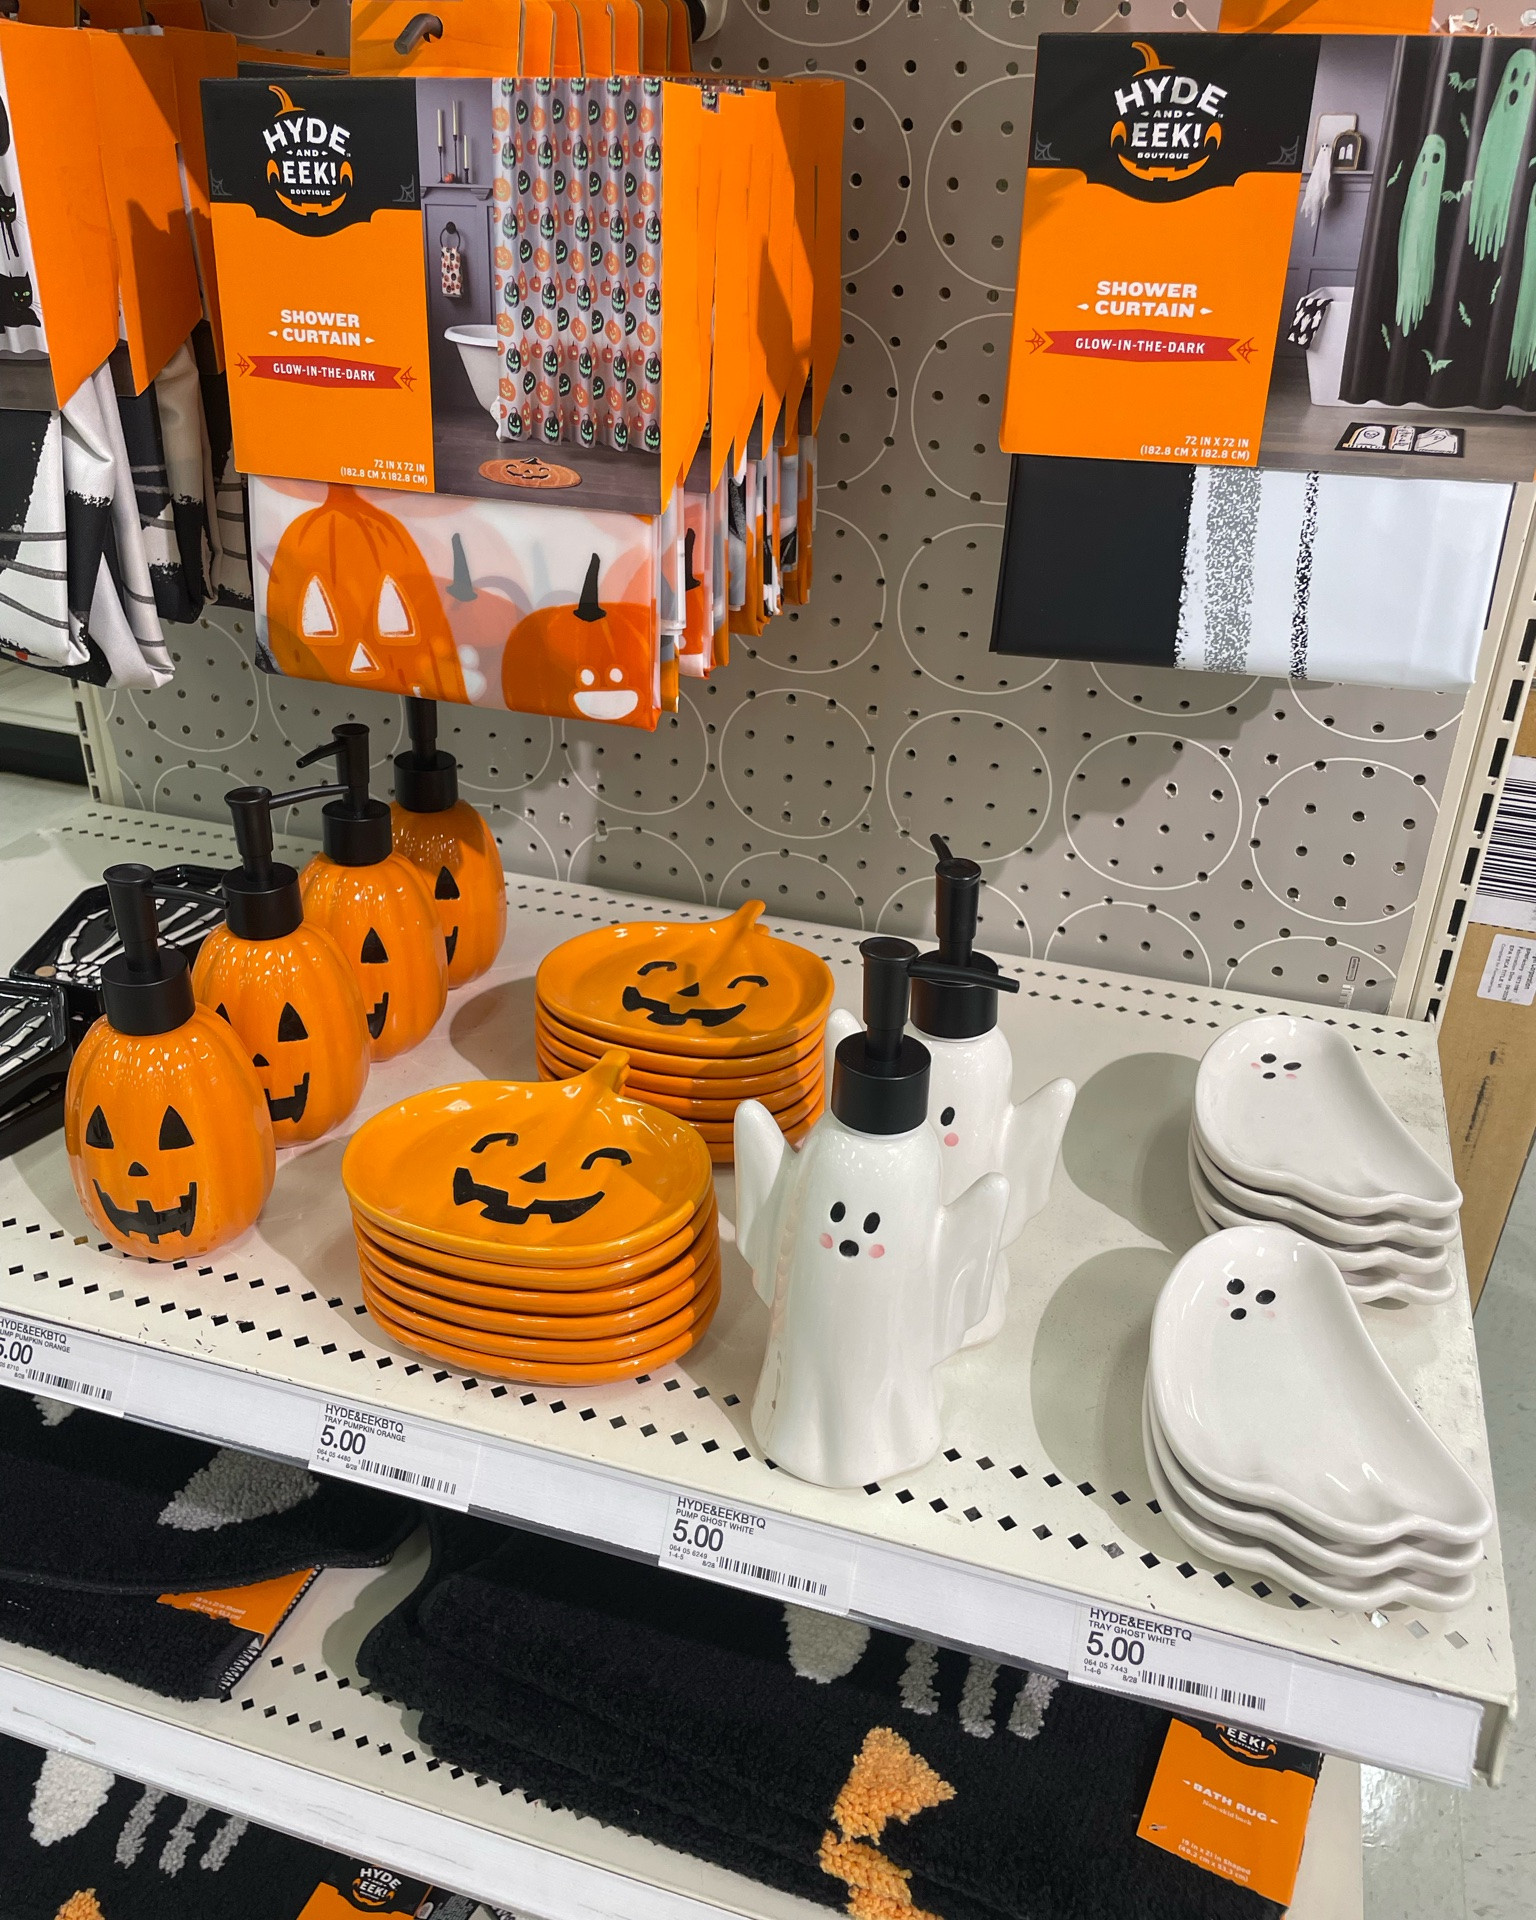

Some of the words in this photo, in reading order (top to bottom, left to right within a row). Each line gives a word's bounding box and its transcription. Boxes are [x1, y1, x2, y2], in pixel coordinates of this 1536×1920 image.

[1114, 75, 1228, 116] HYDE
[1153, 110, 1183, 118] AND
[262, 117, 351, 156] HYDE
[1131, 122, 1202, 148] EEK!
[296, 149, 319, 157] AND
[282, 160, 337, 186] EEK!
[1096, 280, 1198, 299] SHOWER
[280, 309, 360, 328] SHOWER
[1094, 300, 1194, 318] CURTAIN
[282, 328, 361, 346] CURTAIN
[1075, 337, 1206, 354] GLOW-IN-THE-DARK
[273, 362, 376, 382] GLOW-IN-THE-DARK
[1185, 435, 1197, 446] 72
[1200, 436, 1211, 447] IN
[1214, 437, 1221, 447] X
[1222, 438, 1234, 448] 72
[1238, 438, 1249, 449] IN
[1140, 444, 1171, 457] (182.8
[1174, 447, 1189, 458] CM
[1191, 449, 1199, 458] X
[1200, 449, 1228, 460] 182.8
[1231, 450, 1250, 462] CM)
[340, 466, 365, 479] (182.8
[367, 470, 379, 480] CM
[381, 472, 387, 481] X
[388, 472, 411, 483] 182.8
[413, 474, 428, 486] CM)
[373, 459, 384, 469] 72
[386, 460, 395, 470] IN
[397, 462, 403, 471] X
[404, 462, 415, 472] 72
[417, 463, 425, 473] IN
[0, 1318, 67, 1344] HYDE&EEKBTQ
[0, 1328, 14, 1337] UMP
[15, 1333, 43, 1346] PUMPKIN
[44, 1341, 70, 1353] ORANGE
[325, 1403, 404, 1434] HYDE&EEKBTQ
[324, 1415, 342, 1426] TRAY
[343, 1420, 375, 1434] PUMPKIN
[376, 1429, 406, 1443] ORANGE
[320, 1424, 366, 1455] 5.00
[316, 1455, 330, 1463] 1-4-4
[675, 1508, 699, 1520] PUMP
[700, 1515, 727, 1528] GHOST
[729, 1523, 755, 1535] WHITE
[677, 1496, 767, 1530] HYDE&EEKBTQ
[672, 1518, 724, 1552] 5.00
[668, 1551, 684, 1561] 1-4-5
[669, 1543, 681, 1552] 064
[682, 1547, 691, 1555] 05
[692, 1550, 708, 1560] 6249
[702, 1560, 716, 1569] 8/28
[1088, 1619, 1112, 1632] TRAY
[1114, 1626, 1145, 1640] GHOST
[1147, 1633, 1177, 1647] WHITE
[1089, 1607, 1193, 1642] HYDE&EEKBTQ
[1086, 1630, 1145, 1666] 5.00
[1083, 1658, 1098, 1667] 064
[1099, 1662, 1109, 1670] 05
[1110, 1664, 1128, 1674] 7443
[1083, 1665, 1102, 1676] 1-4-6
[1122, 1675, 1138, 1684] 8/28
[1227, 1727, 1266, 1751] EEK!
[1193, 1782, 1232, 1806] BATH
[1236, 1802, 1268, 1822] RUG
[1202, 1799, 1235, 1819] Non-skid
[360, 1867, 401, 1890] HYDE
[359, 1880, 388, 1898] EEK!
